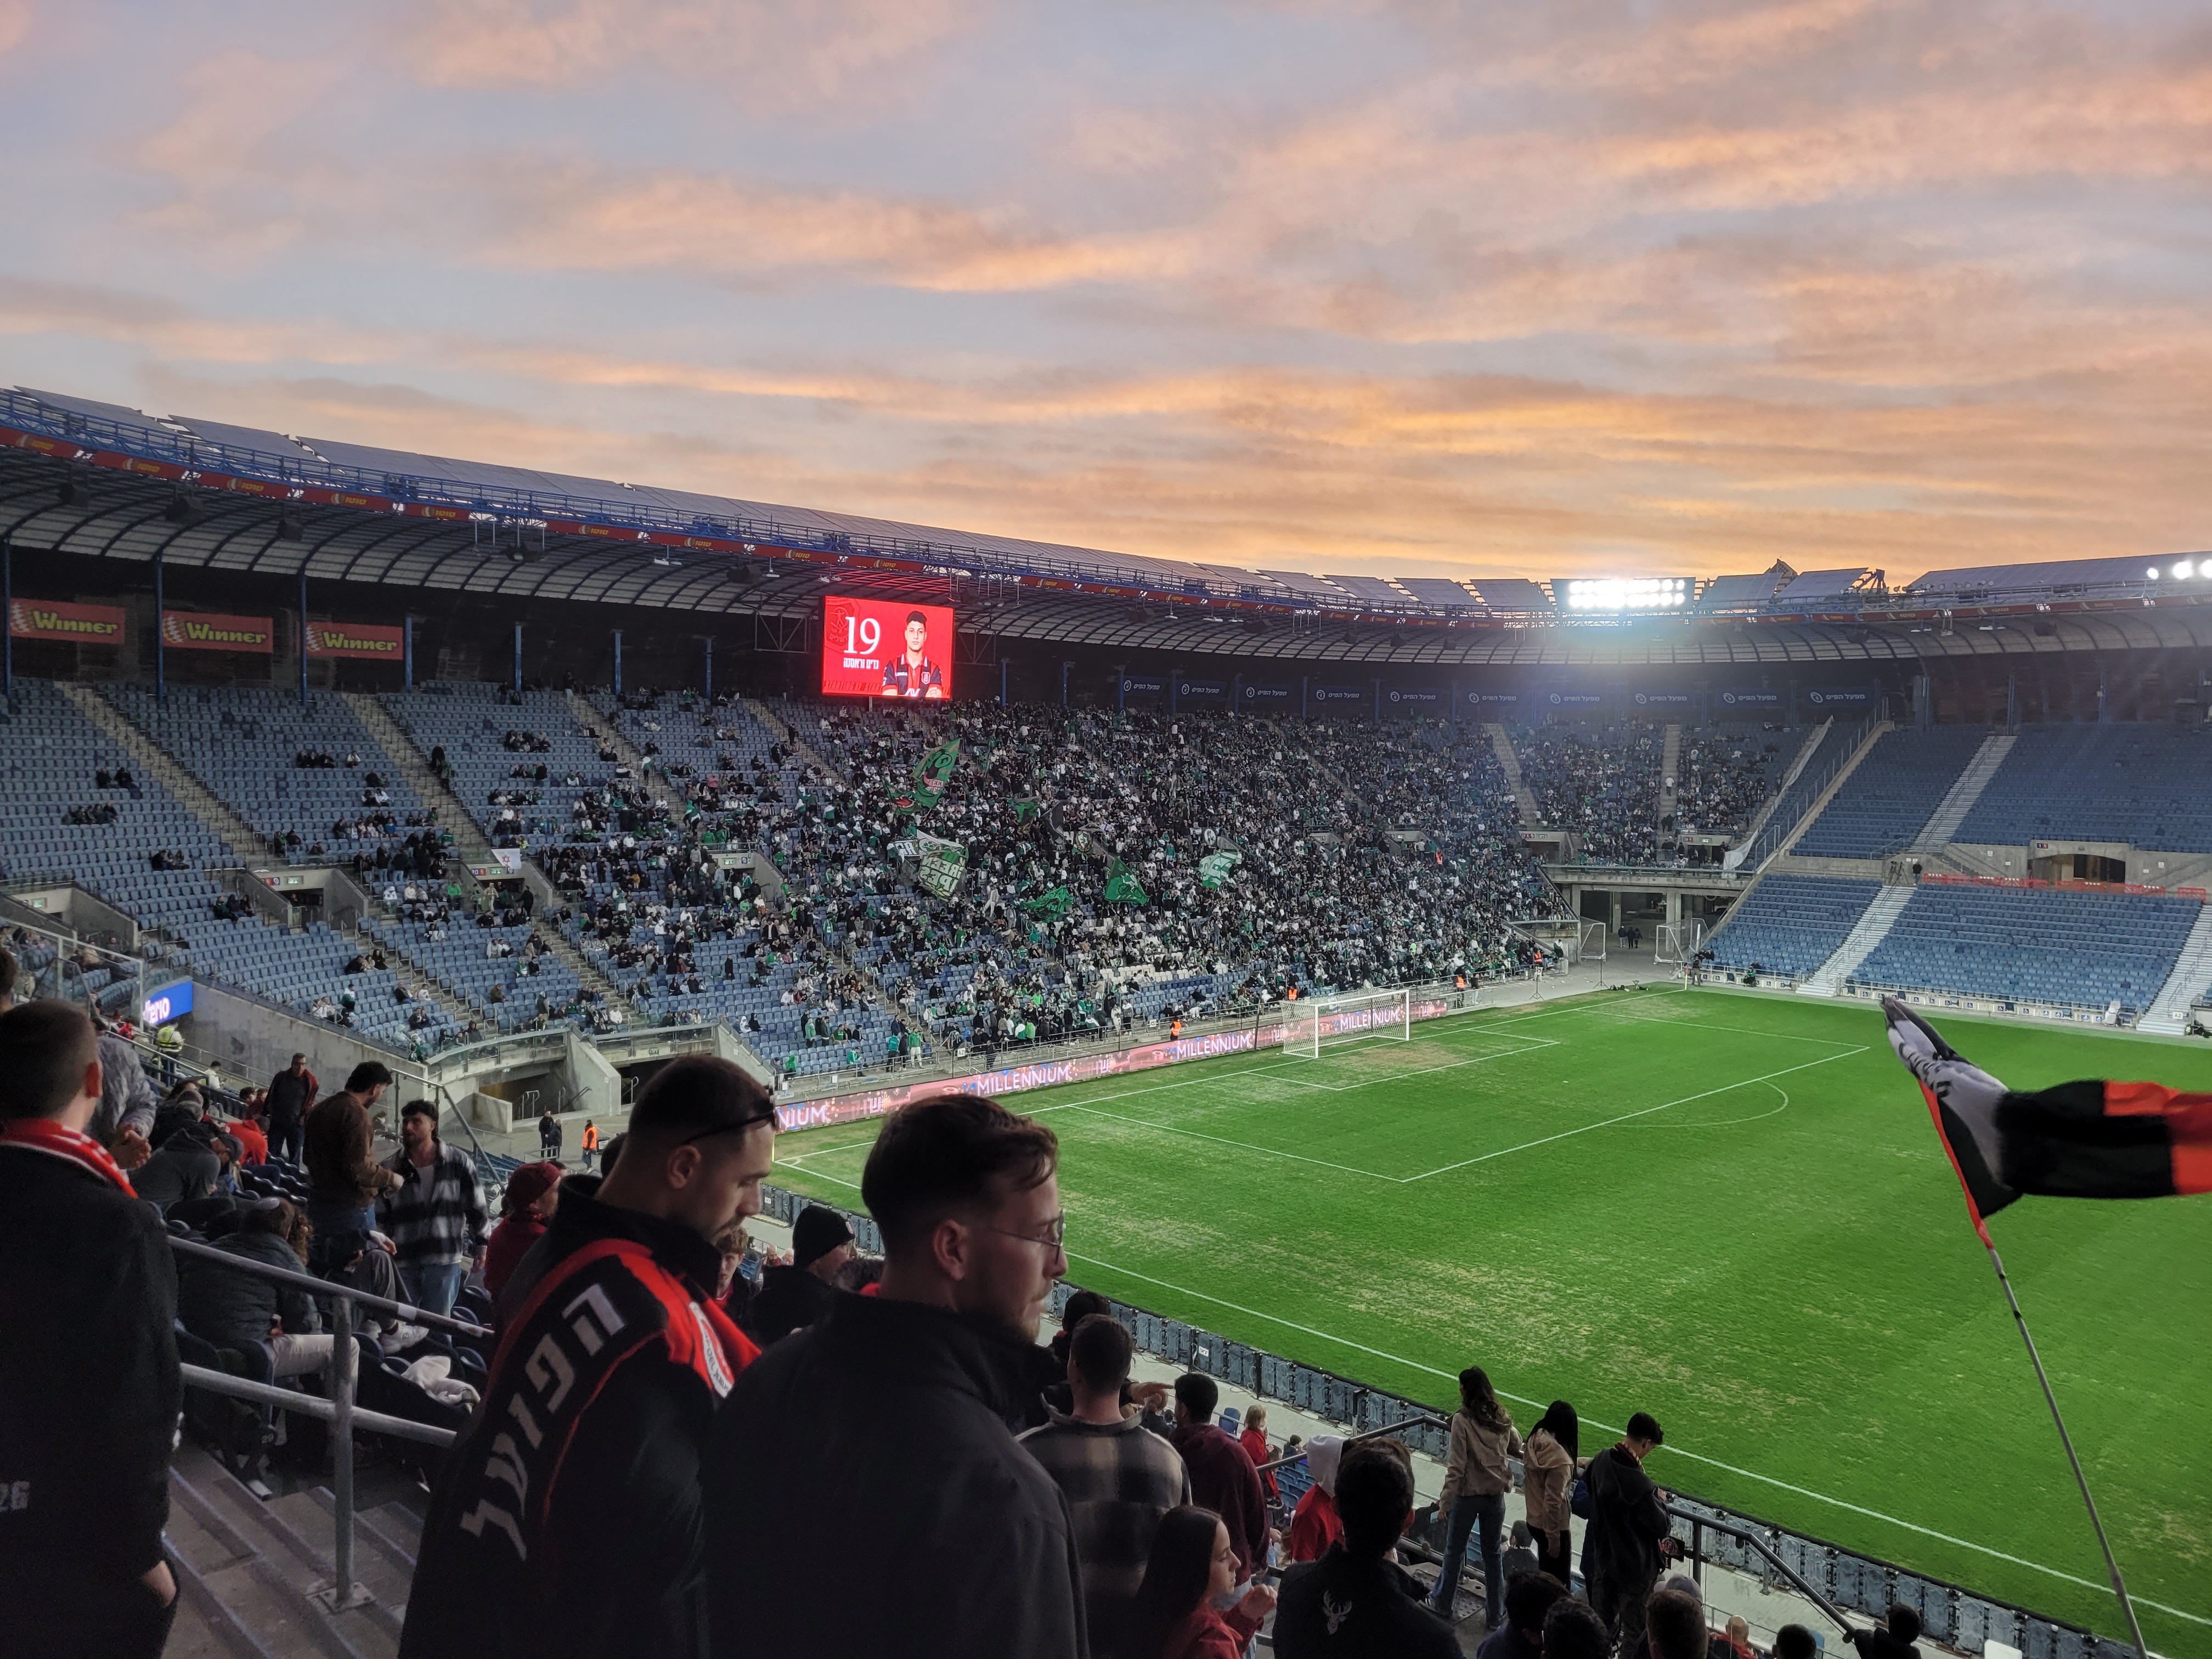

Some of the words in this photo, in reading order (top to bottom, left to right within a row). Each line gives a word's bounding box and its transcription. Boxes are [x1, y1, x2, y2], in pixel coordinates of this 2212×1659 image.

[32, 610, 117, 634] Winner
[186, 622, 267, 644] Winner
[323, 631, 397, 651] Winner
[843, 616, 880, 654] 19
[866, 659, 879, 670] נדים
[1340, 1009, 1399, 1031] MILLENNIUM
[1177, 1034, 1251, 1060] MILLENNIUM
[977, 1065, 1070, 1096] MILLENNIUM
[460, 1283, 626, 1561] הפועל
